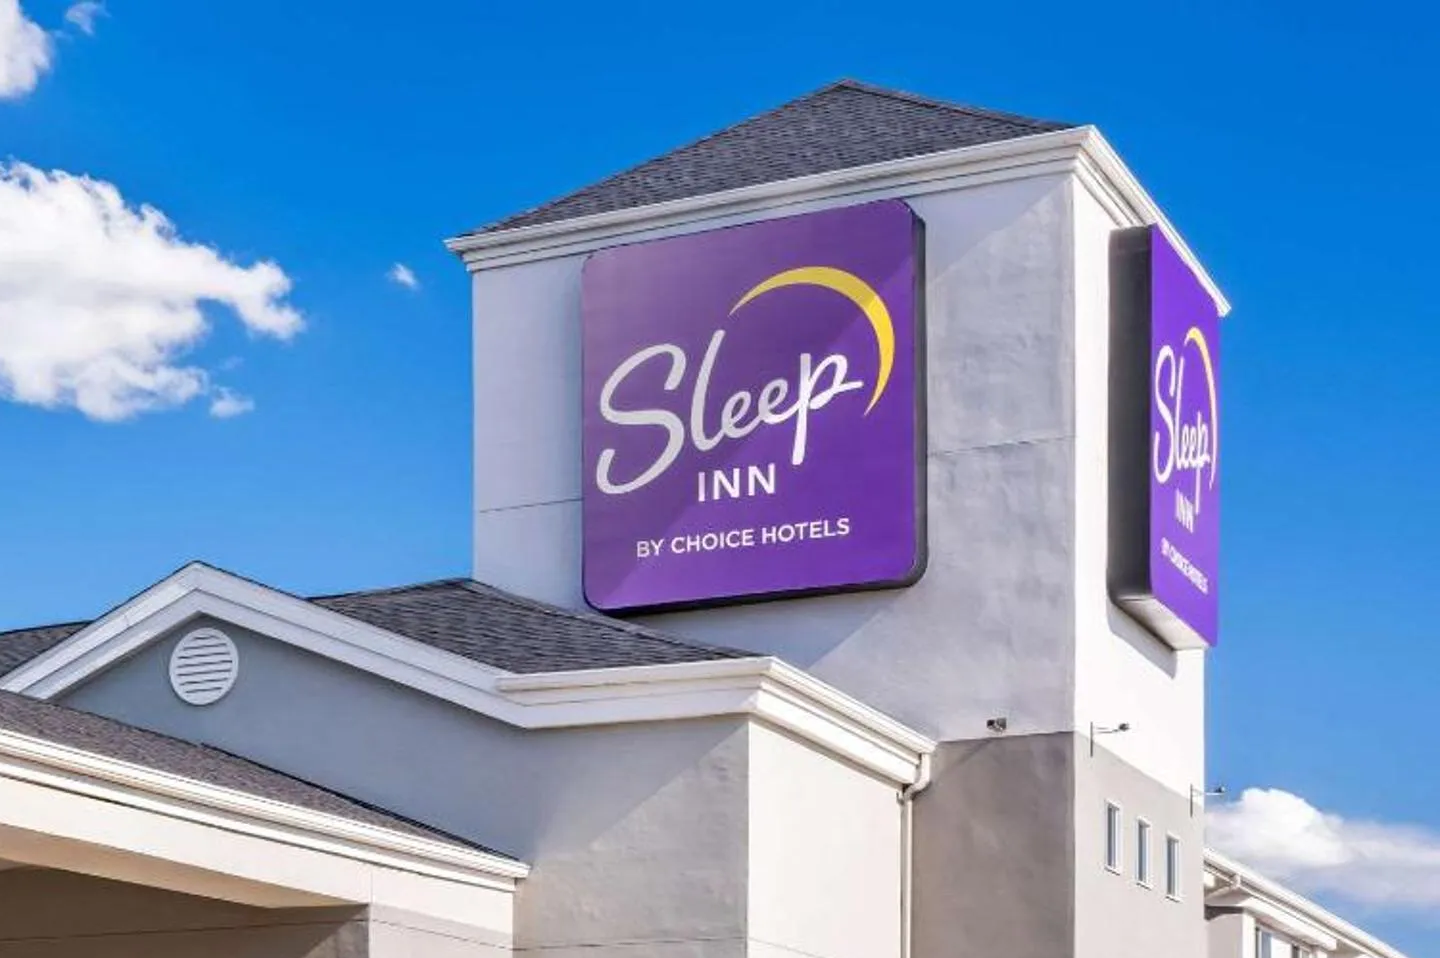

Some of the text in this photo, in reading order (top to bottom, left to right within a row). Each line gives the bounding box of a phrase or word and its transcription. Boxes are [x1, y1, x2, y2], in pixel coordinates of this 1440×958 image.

[596, 329, 863, 495] Sleep
[1153, 344, 1210, 515] Sleep
[698, 463, 776, 502] INN
[636, 517, 850, 558] BY CHOICE HOTELS
